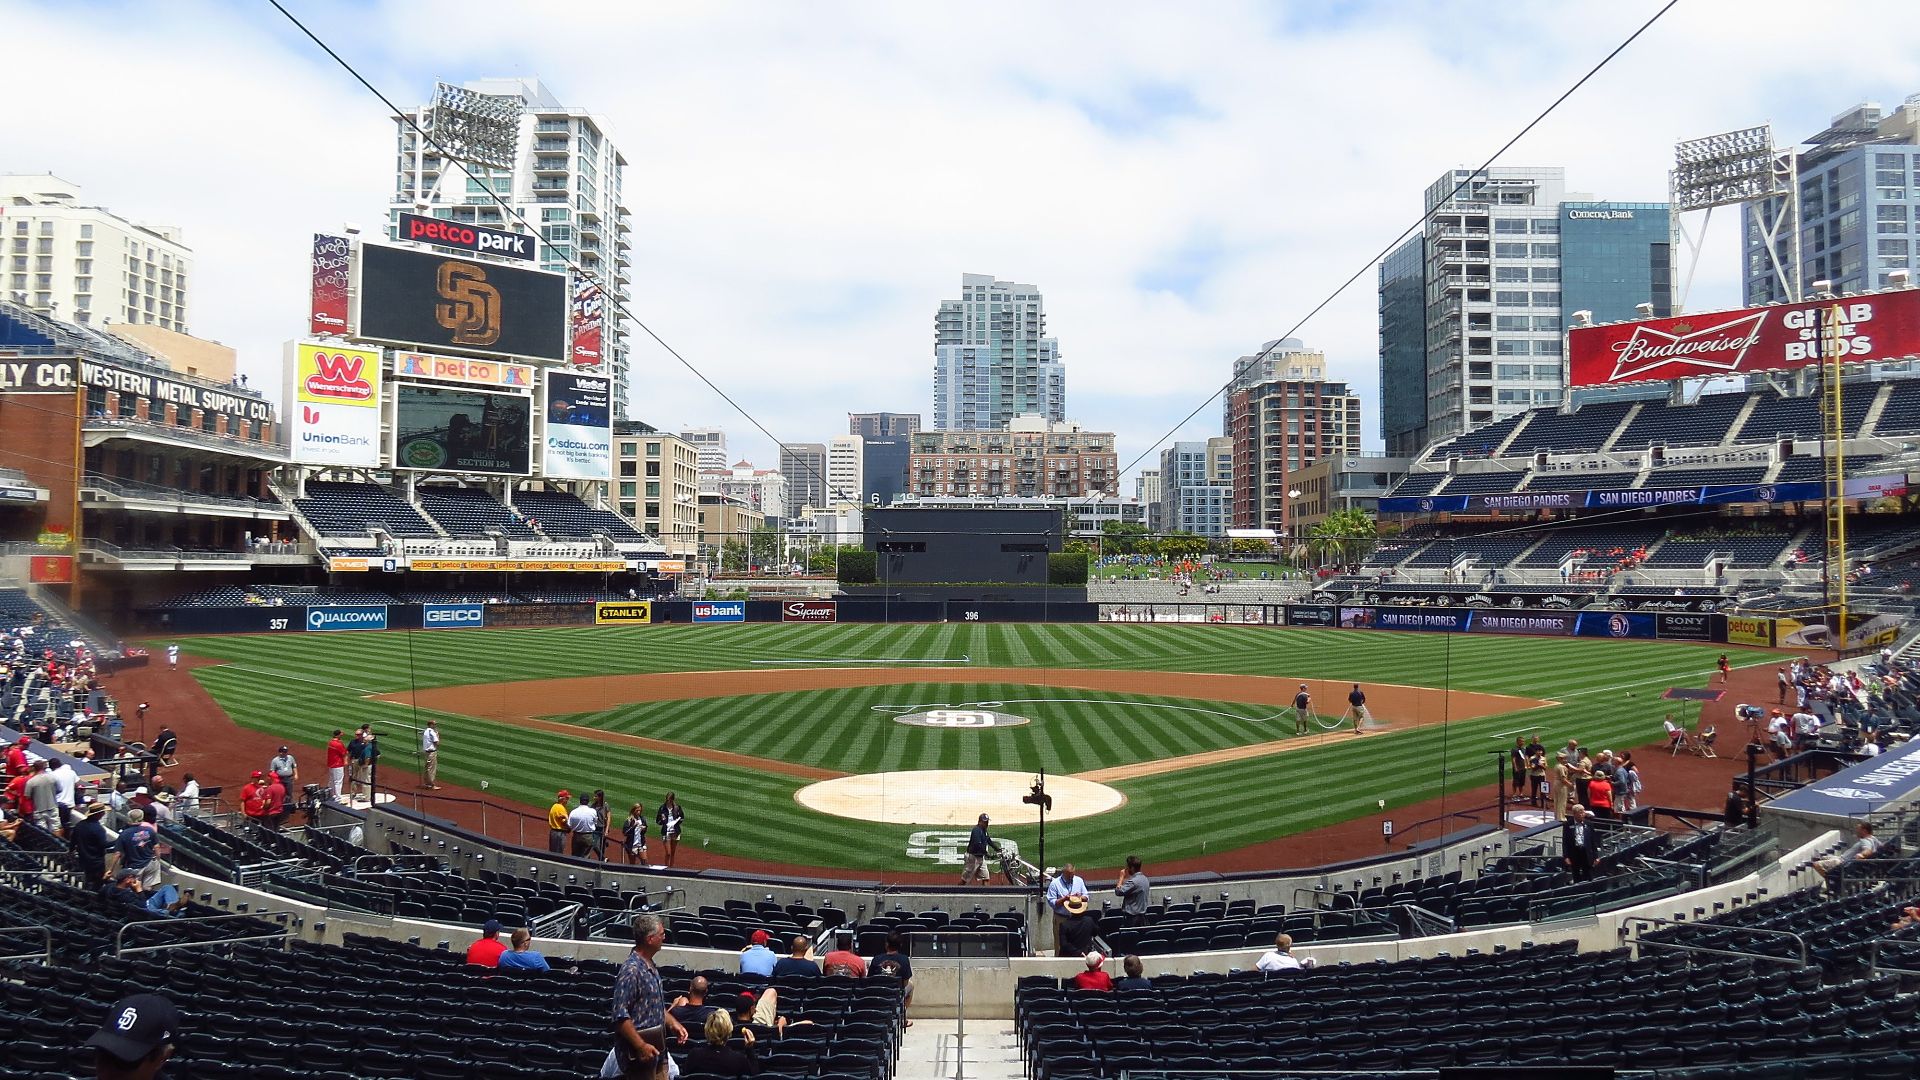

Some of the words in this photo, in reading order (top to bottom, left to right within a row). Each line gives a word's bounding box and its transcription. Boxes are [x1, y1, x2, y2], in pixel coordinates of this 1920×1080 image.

[1612, 211, 1633, 219] Bank
[411, 219, 476, 244] petco
[478, 231, 525, 253] park
[1611, 332, 1760, 364] Budweiser
[36, 363, 77, 387] CO.
[435, 361, 490, 378] petco
[81, 362, 151, 396] WESTERN
[157, 380, 200, 406] METAL
[202, 391, 247, 416] SUPPLY
[250, 402, 269, 421] CO.
[558, 439, 608, 451] sdccu.com
[457, 458, 494, 467] SECTION
[495, 460, 510, 468] 124
[871, 493, 880, 503] 6
[900, 493, 915, 501] 19
[1484, 497, 1501, 508] SAN
[1503, 495, 1531, 507] DIEGO
[1533, 494, 1570, 506] PADRES
[1600, 492, 1619, 504] SAN
[1621, 491, 1652, 503] DIEGO
[1655, 489, 1696, 502] PADRES
[412, 561, 432, 569] petco
[441, 561, 460, 569] petco
[470, 561, 489, 569] petco
[499, 562, 517, 570] petco
[525, 562, 543, 570] petco
[552, 562, 569, 570] petco
[577, 562, 594, 570] petco
[602, 561, 619, 569] petco
[426, 609, 481, 622] GEICO
[602, 608, 644, 617] STANLEY
[788, 602, 833, 620] Sycuan
[964, 611, 979, 621] 396
[270, 618, 288, 630] 357
[309, 610, 385, 628] QUALCOMM
[1382, 614, 1398, 625] SAN
[1399, 614, 1423, 625] DIEGO
[1425, 615, 1457, 626] PADRES
[1482, 616, 1498, 627] SAN
[1500, 617, 1527, 628] DIEGO
[1528, 618, 1564, 629] PADRES
[1665, 616, 1705, 625] SONY
[1728, 620, 1756, 634] petco
[117, 1007, 138, 1031] SD
